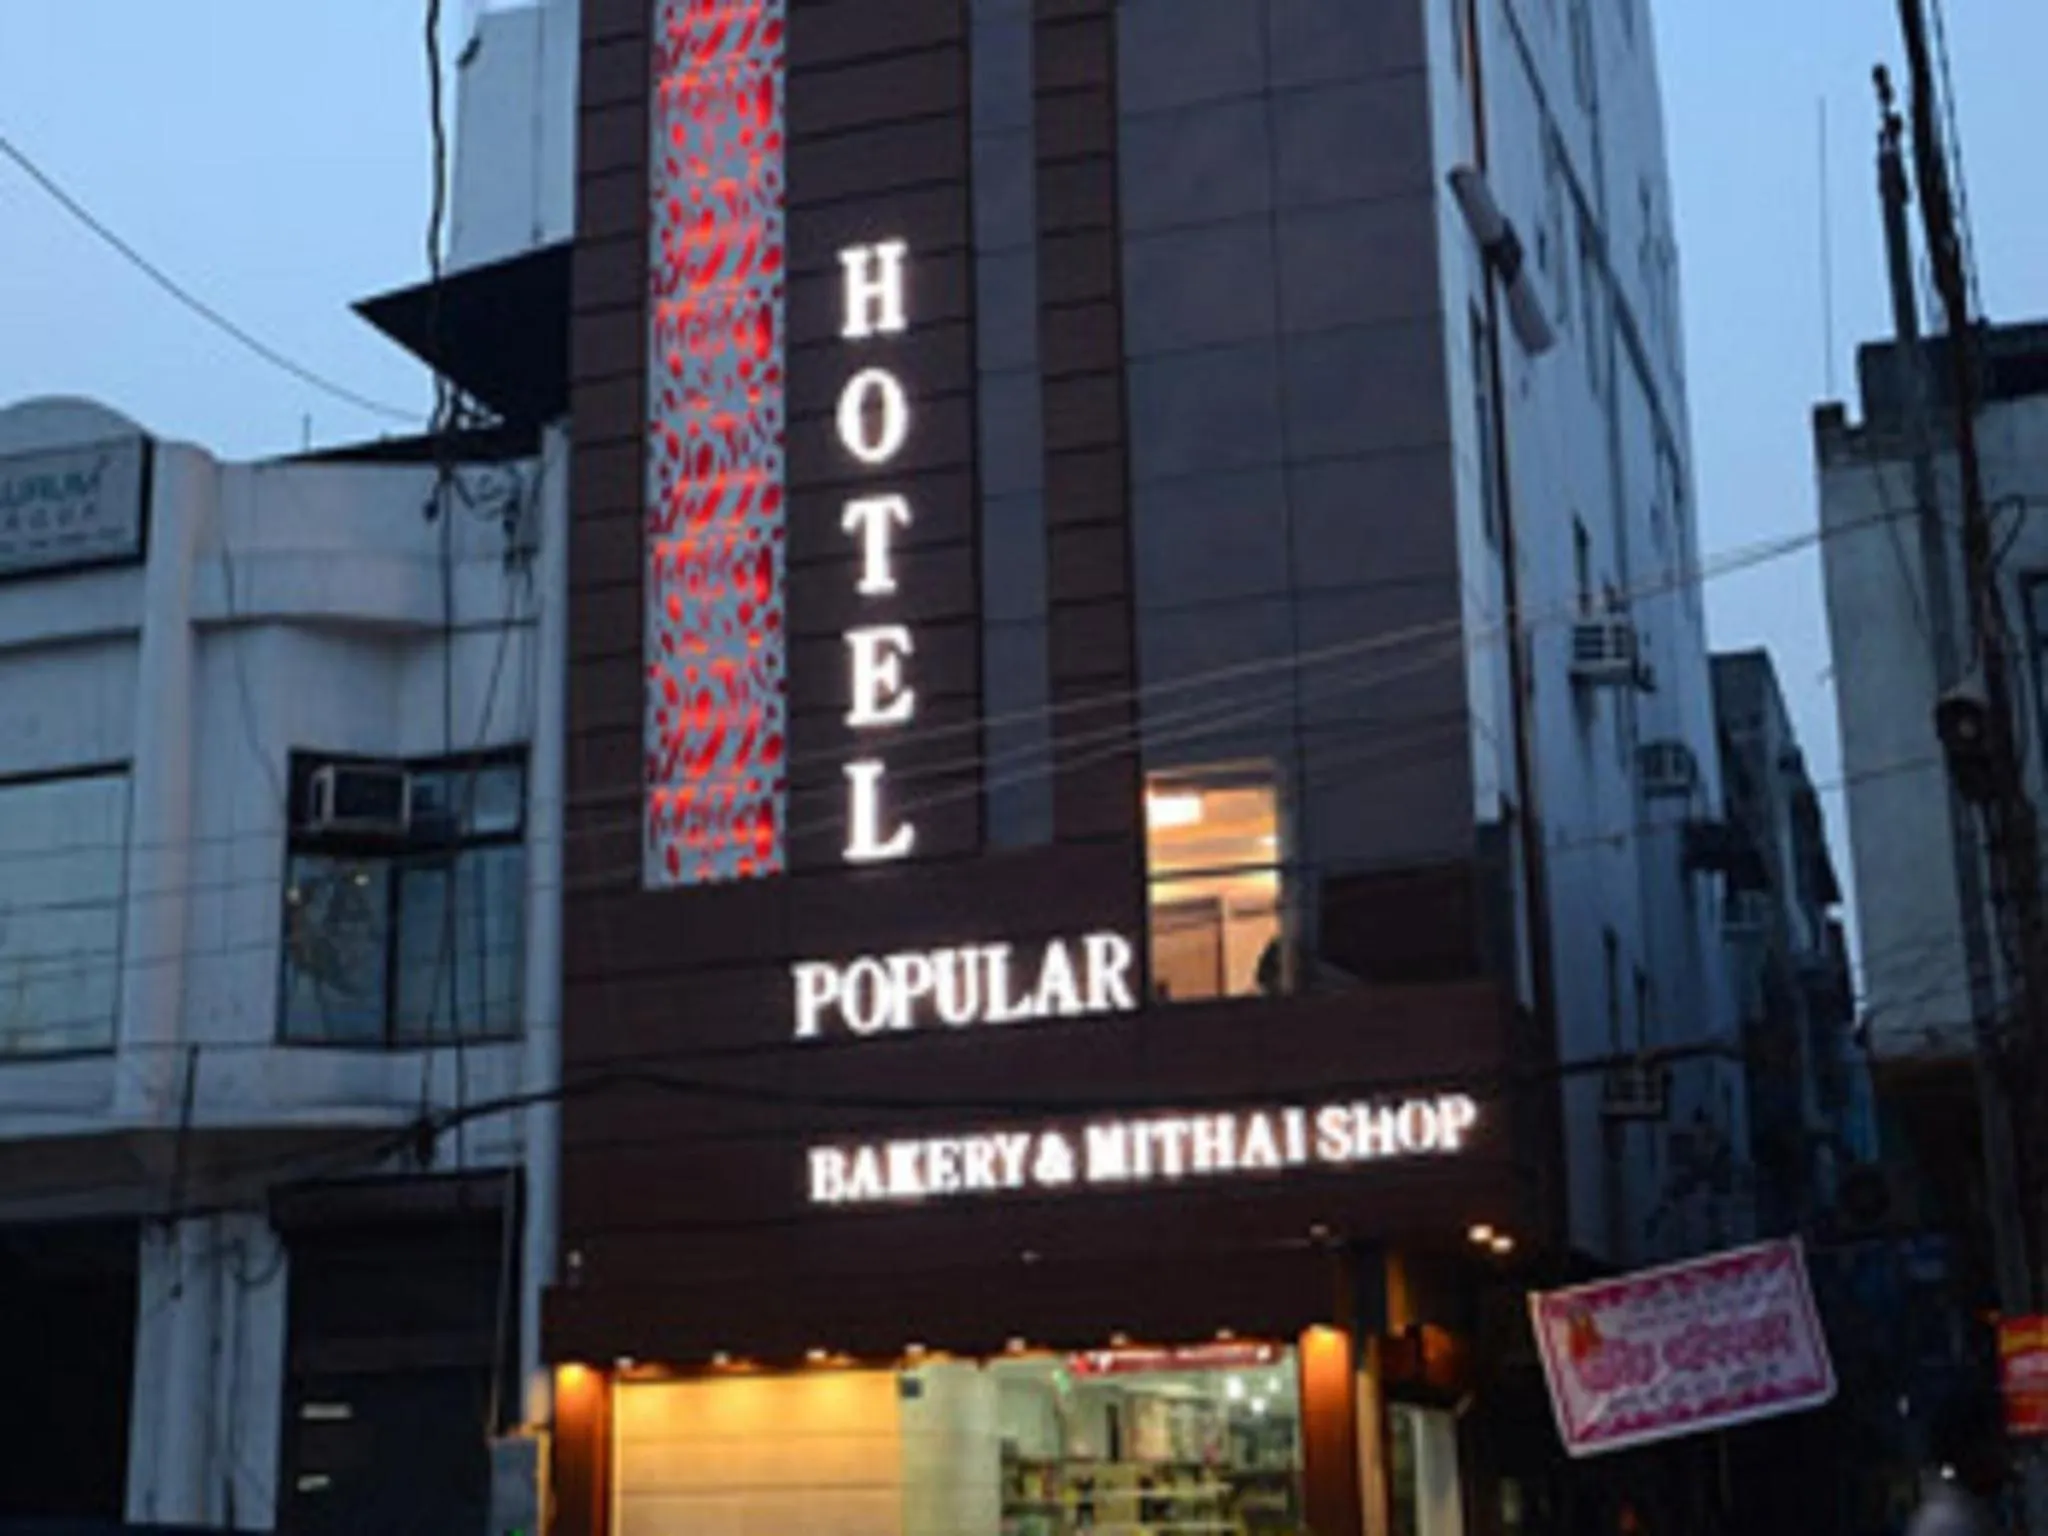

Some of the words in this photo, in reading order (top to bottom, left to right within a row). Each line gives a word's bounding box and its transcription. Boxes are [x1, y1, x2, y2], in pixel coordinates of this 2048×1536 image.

[836, 239, 915, 863] HOTEL
[792, 931, 1134, 1038] POPULAR
[807, 1131, 1031, 1203] BAKERY
[1032, 1130, 1075, 1186] &
[1083, 1105, 1306, 1184] MITHAI
[1315, 1093, 1478, 1165] SHOP
